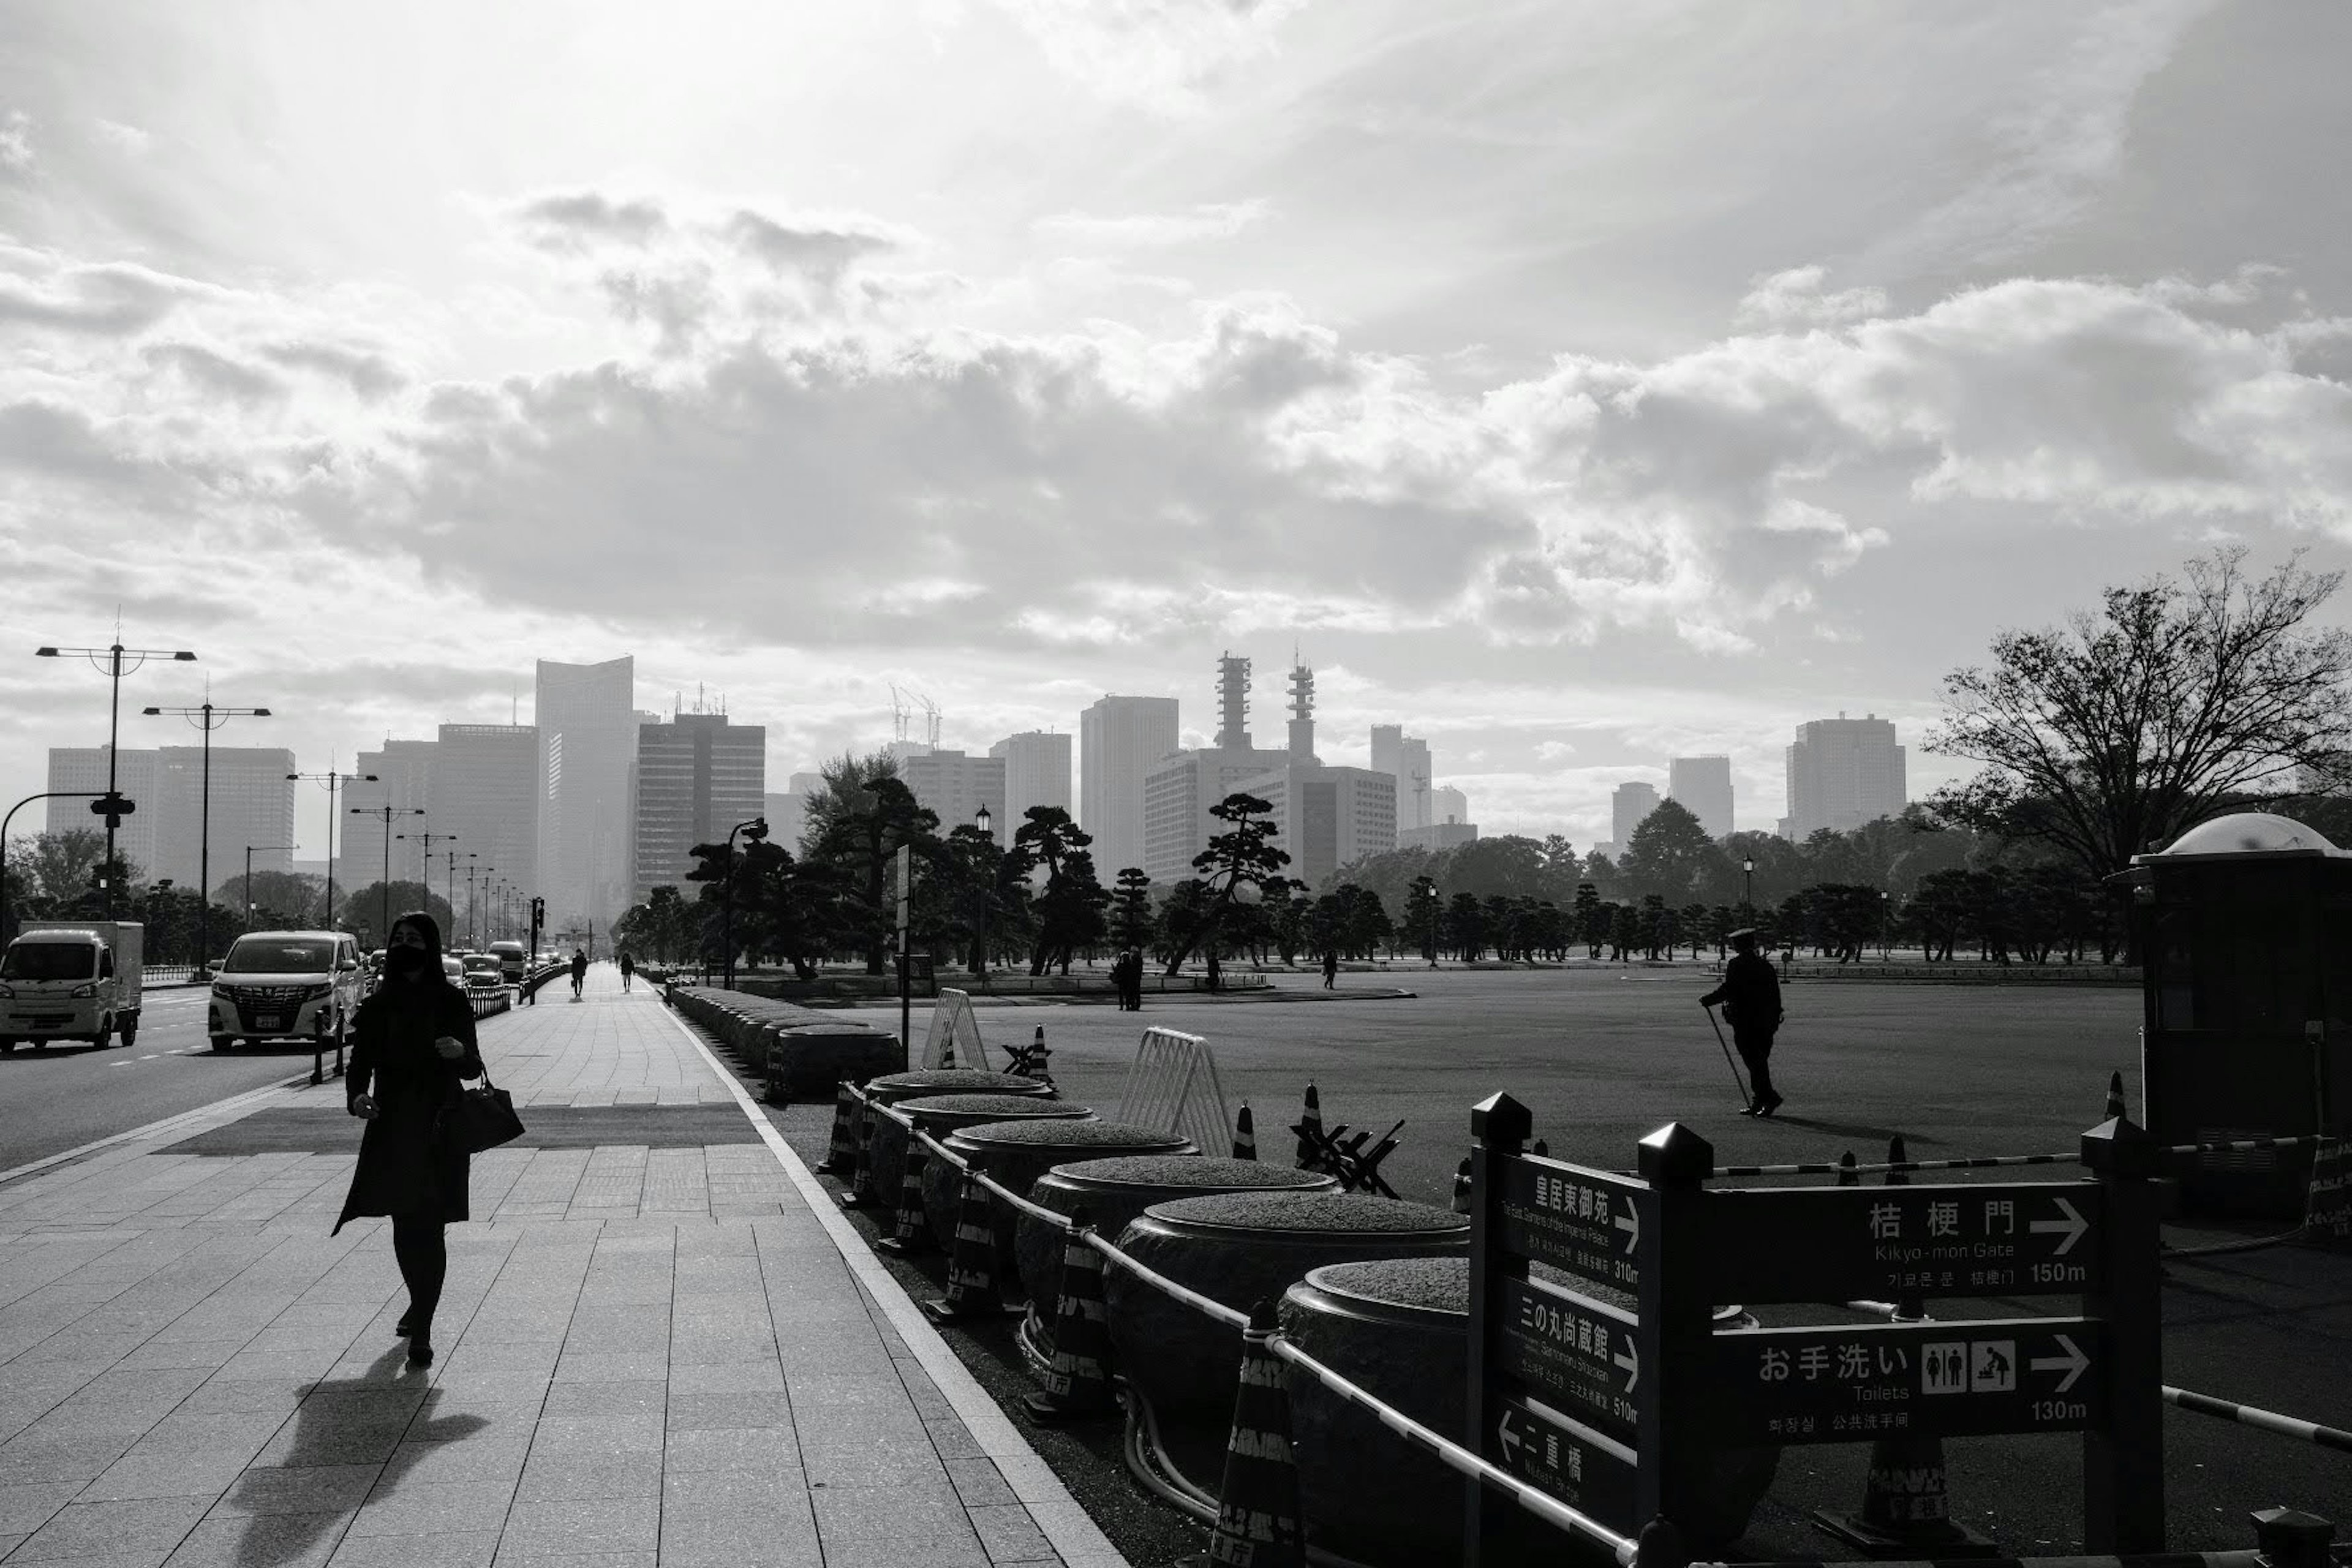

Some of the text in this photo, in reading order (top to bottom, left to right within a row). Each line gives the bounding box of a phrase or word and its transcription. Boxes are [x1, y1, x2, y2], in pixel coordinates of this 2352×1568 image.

[1535, 1173, 1609, 1225] 皇居東御苑
[1869, 1200, 2015, 1240] 桔梗門
[1973, 1242, 2015, 1259] Gate
[2030, 1262, 2086, 1284] 150m
[1520, 1295, 1608, 1362] 三の丸尚蔵館
[1758, 1343, 1908, 1382] お手洗い
[1853, 1385, 1910, 1403] Toilets
[1832, 1411, 1909, 1431] 公共洗手间
[2031, 1401, 2087, 1422] 130m
[1524, 1424, 1581, 1483] 二重橋
